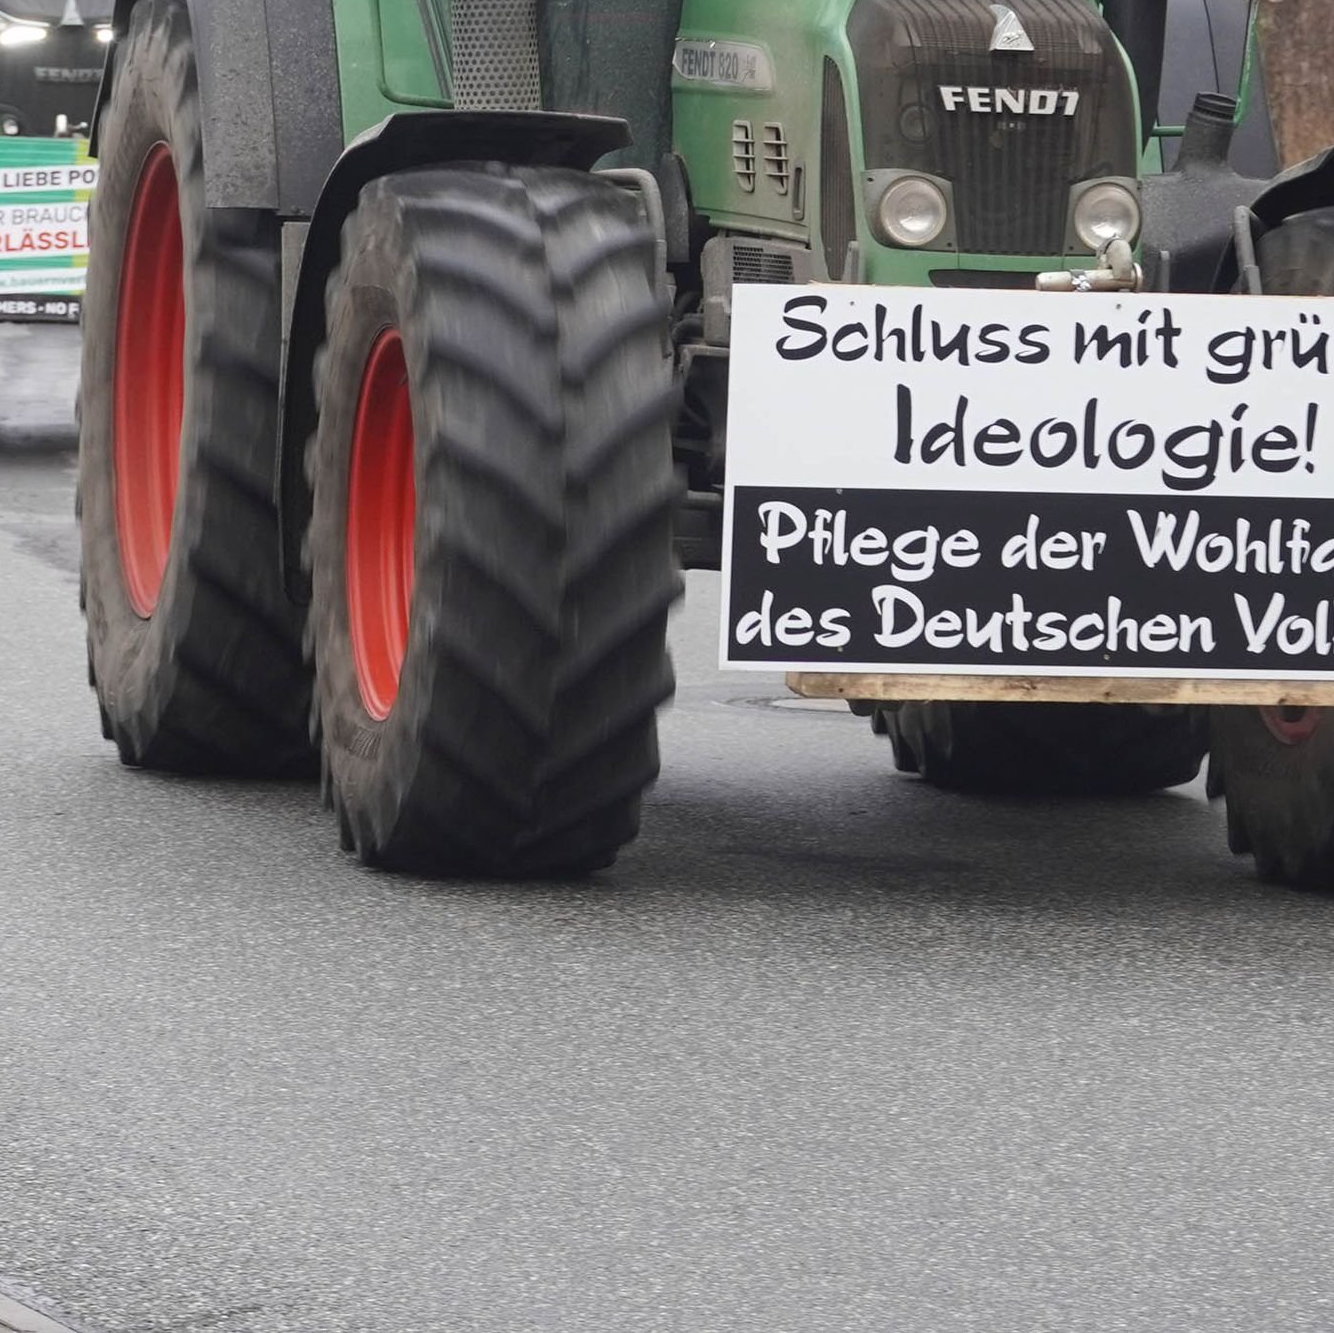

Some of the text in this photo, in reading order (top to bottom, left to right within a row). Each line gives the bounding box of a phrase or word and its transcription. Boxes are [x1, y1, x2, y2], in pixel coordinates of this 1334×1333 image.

[681, 48, 716, 78] FENDT
[719, 53, 739, 80] 820
[939, 86, 1080, 116] FENDT
[3, 170, 62, 188] LIEBE
[12, 205, 89, 225] BRAUC
[46, 302, 67, 315] NO
[776, 295, 1051, 366] Schluss
[1074, 308, 1182, 369] mit
[894, 383, 1319, 491] Ideologie!
[758, 500, 982, 582] Pflege
[1001, 513, 1108, 571] der
[735, 589, 852, 648] des
[871, 584, 1216, 654] Deutschen
